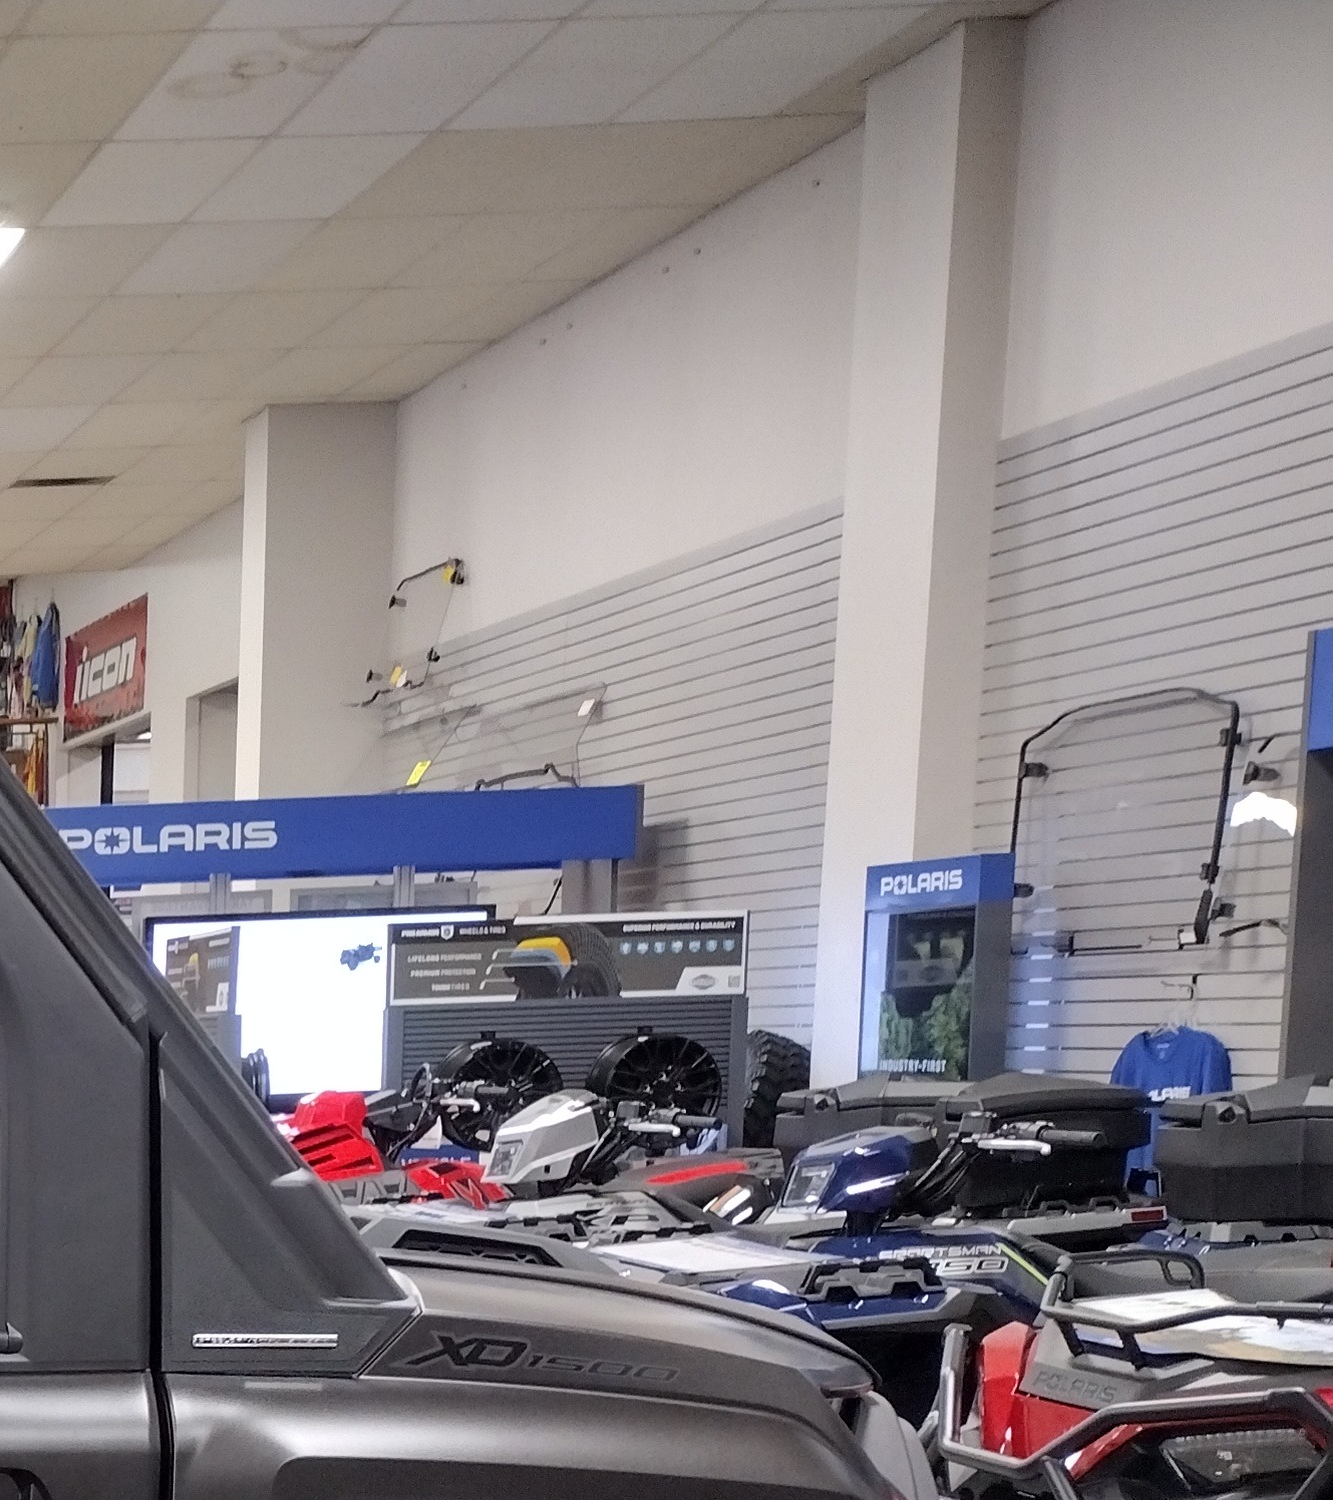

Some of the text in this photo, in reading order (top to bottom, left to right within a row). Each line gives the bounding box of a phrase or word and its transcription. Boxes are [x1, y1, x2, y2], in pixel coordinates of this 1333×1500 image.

[58, 820, 278, 855] POLARIS
[880, 869, 963, 896] POLARIS
[405, 1333, 680, 1381] XD 1500
